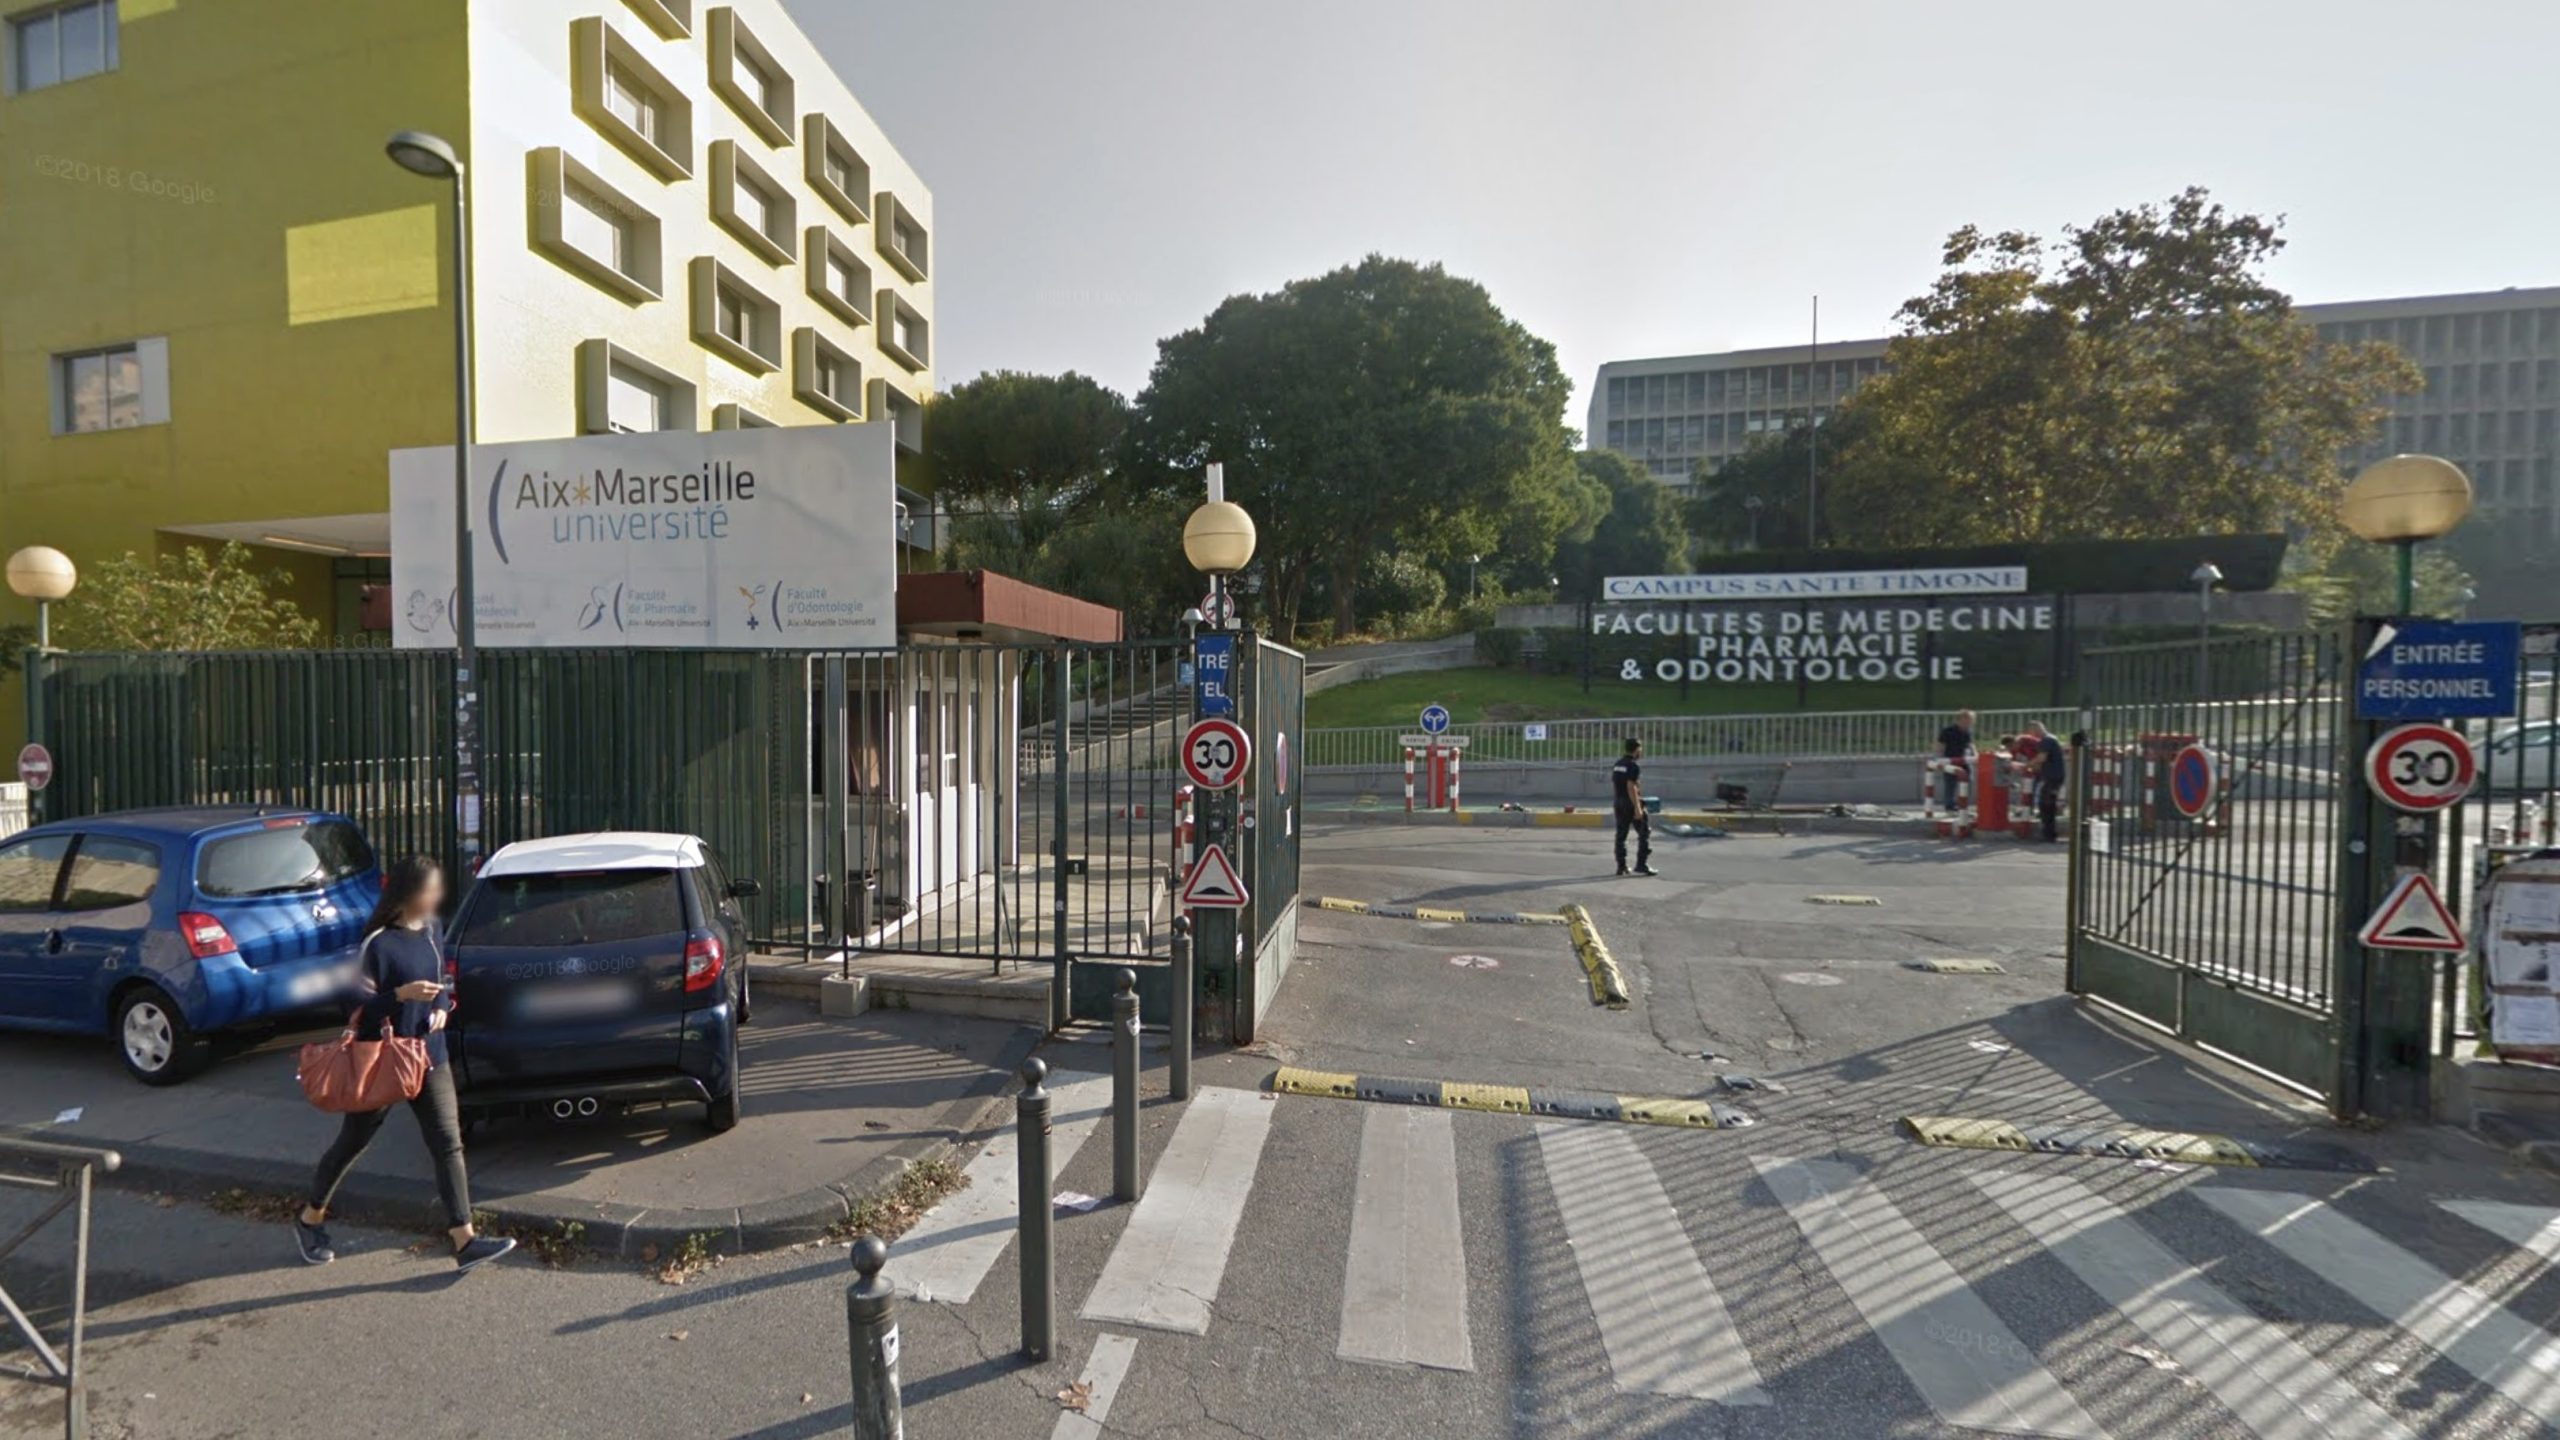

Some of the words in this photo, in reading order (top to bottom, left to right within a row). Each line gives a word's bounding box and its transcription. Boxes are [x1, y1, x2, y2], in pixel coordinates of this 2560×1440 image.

[553, 504, 729, 543] université
[1609, 579, 1745, 595] CAMPUS
[1754, 576, 1864, 593] SANTE
[1875, 572, 2022, 591] TIMONE
[1592, 612, 1764, 636] FACULTES
[1780, 611, 1825, 635] DE
[1838, 606, 2052, 633] MEDECINE
[1699, 634, 1918, 659] PHARMACIE
[2392, 640, 2486, 665] ENTRÉE
[1619, 658, 1644, 681] &
[1655, 656, 1964, 682] ODONTOLOGIE
[2363, 678, 2496, 699] PERSONNEL
[1195, 739, 1235, 770] 30
[2394, 750, 2455, 787] 30
